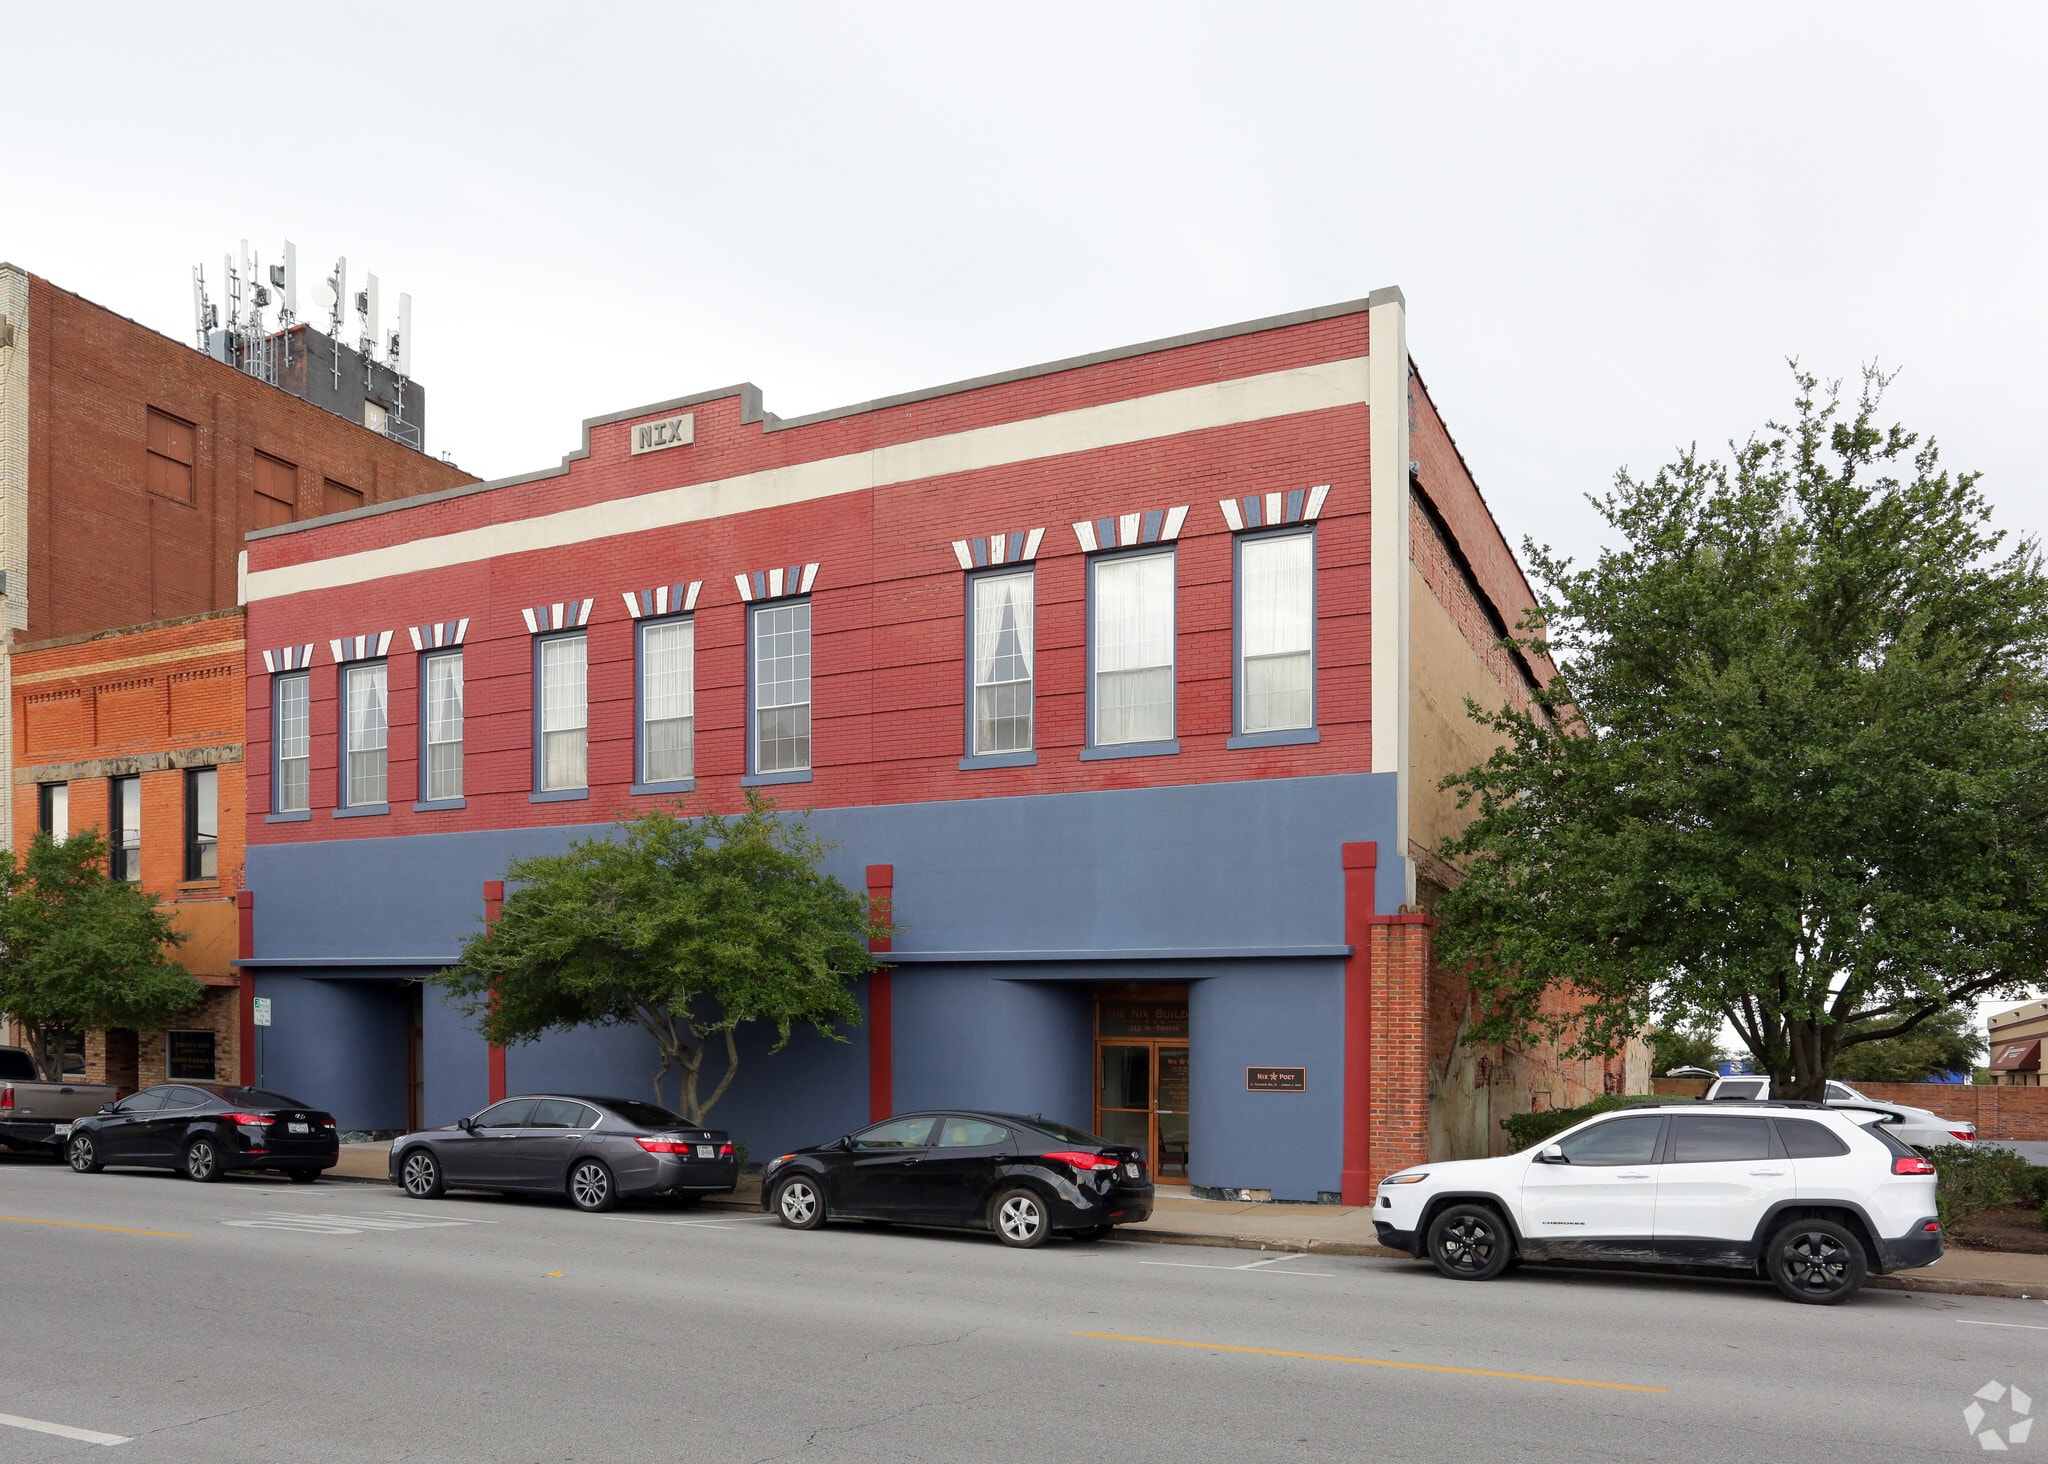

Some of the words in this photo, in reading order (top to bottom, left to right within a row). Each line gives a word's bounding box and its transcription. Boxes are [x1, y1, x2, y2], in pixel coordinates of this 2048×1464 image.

[639, 419, 682, 448] NIX
[1104, 1009, 1126, 1018] THE
[1131, 1008, 1149, 1018] NIX
[1279, 1073, 1295, 1081] POET
